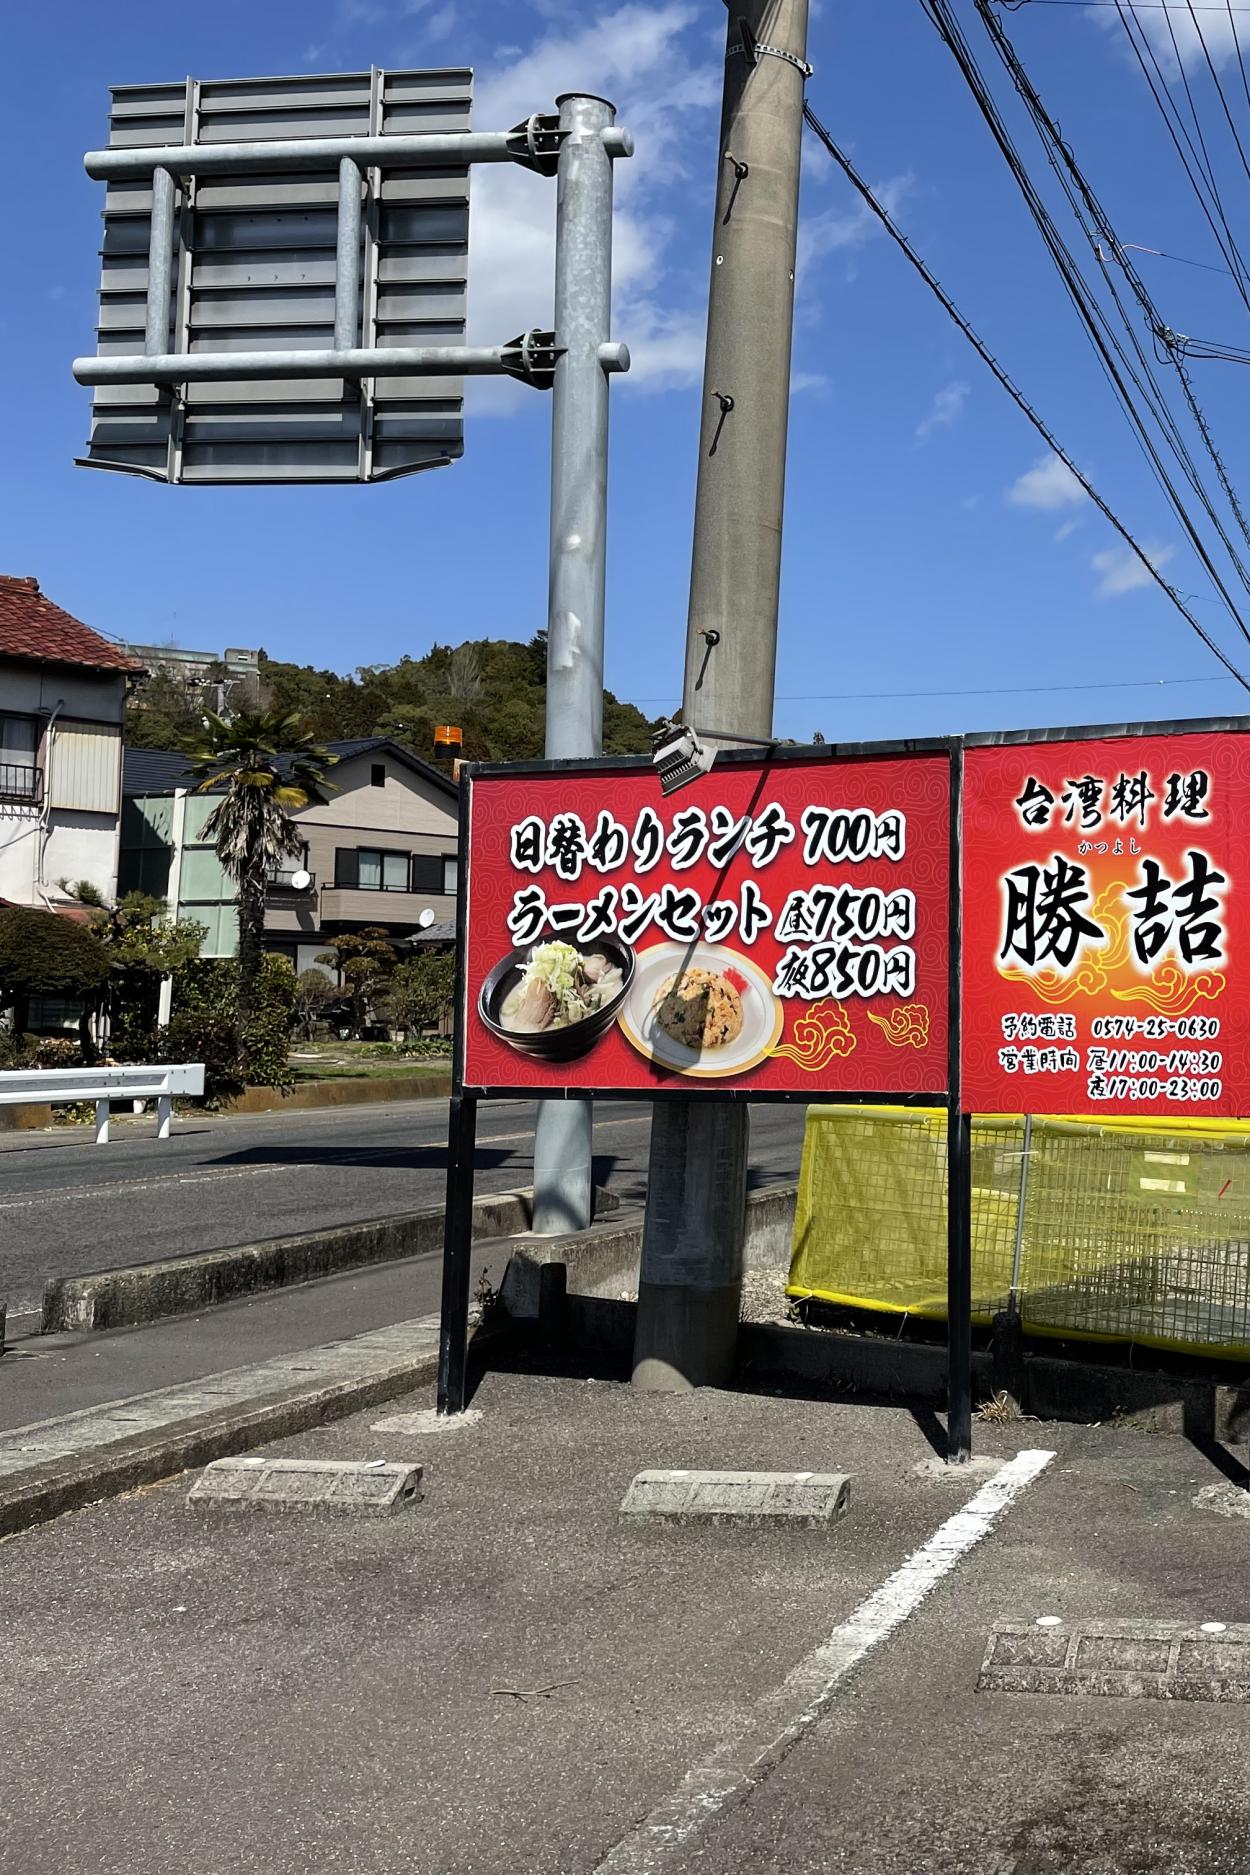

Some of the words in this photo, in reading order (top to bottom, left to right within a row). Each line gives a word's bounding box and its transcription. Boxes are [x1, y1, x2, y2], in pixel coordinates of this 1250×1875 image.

[1016, 769, 1210, 829] 台湾料理
[513, 804, 793, 876] 日替わりランチ
[805, 808, 904, 863] 700円
[1078, 838, 1142, 855] かつよし
[511, 882, 772, 943] ラーメンセット
[1003, 1014, 1076, 1039] 予約電話
[1093, 1016, 1219, 1037] 0574-25-0630
[1000, 1048, 1079, 1072] 営業時間
